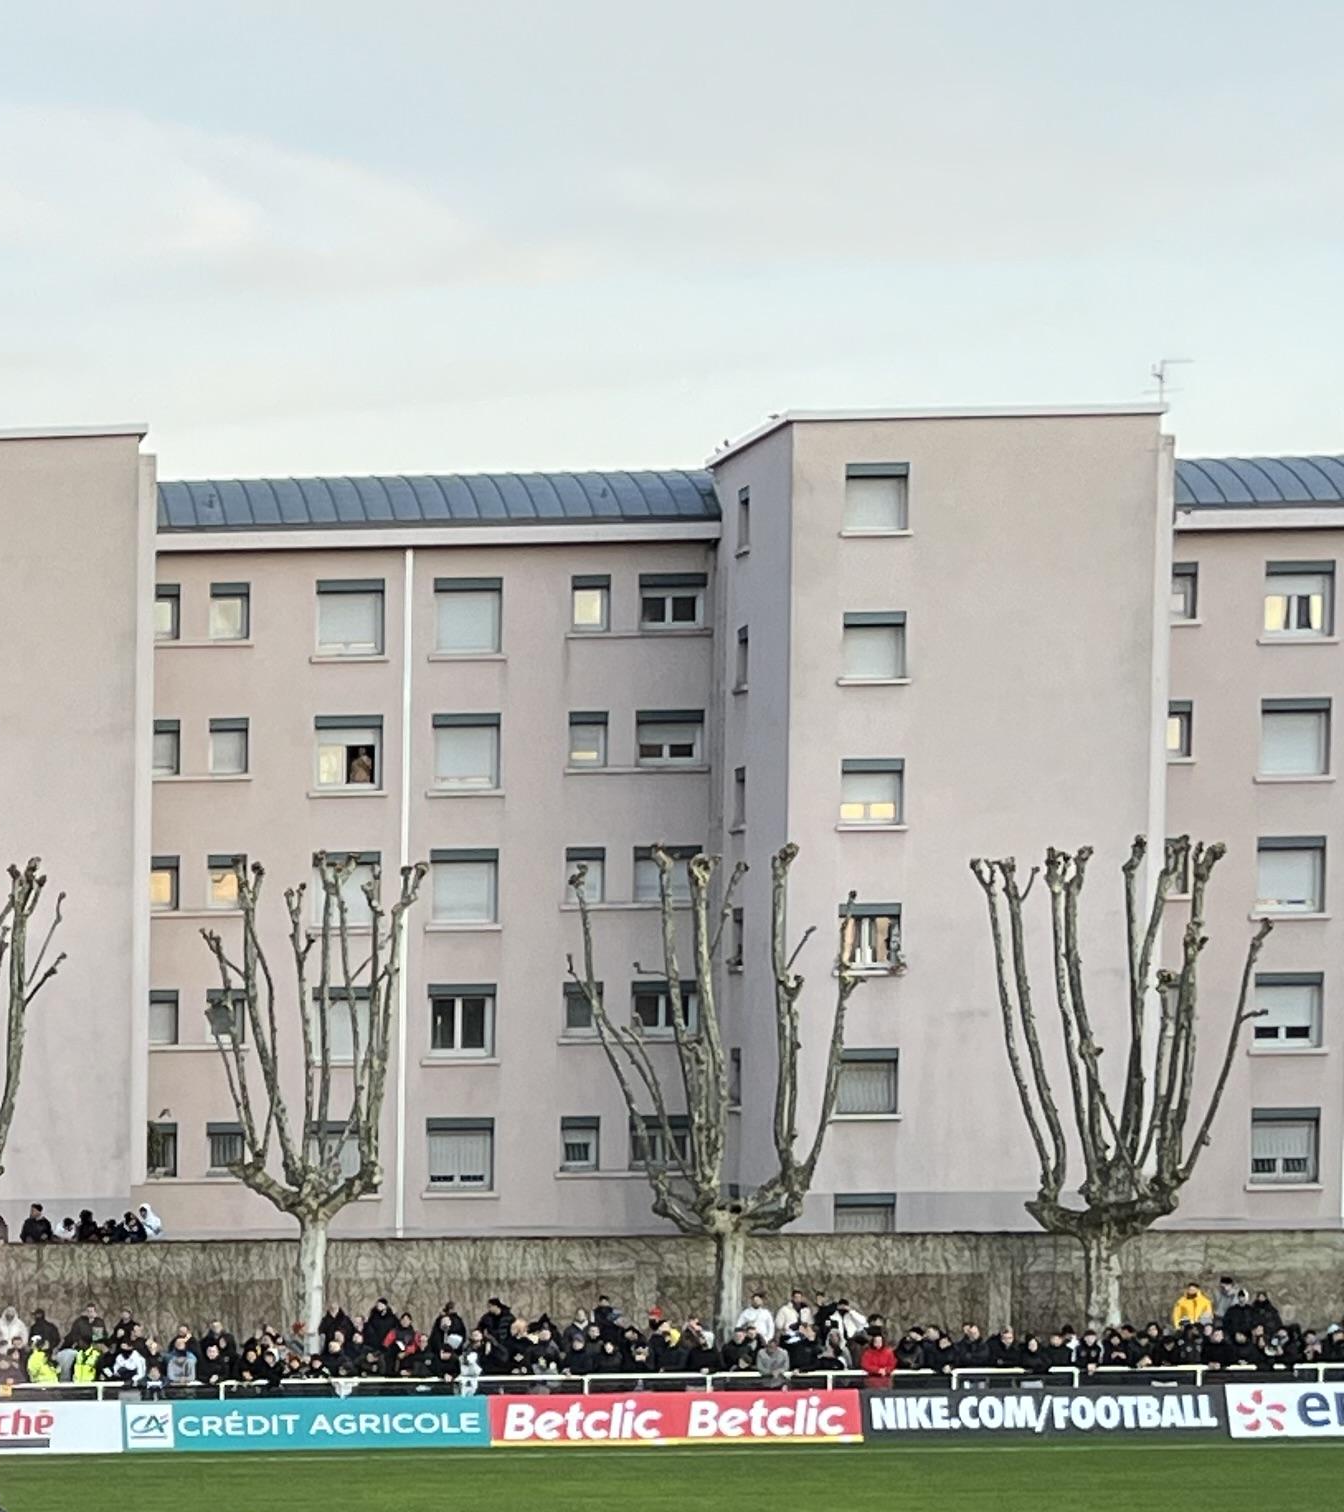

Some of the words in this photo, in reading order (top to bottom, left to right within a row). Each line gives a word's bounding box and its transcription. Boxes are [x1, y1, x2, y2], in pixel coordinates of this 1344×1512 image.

[178, 1410, 300, 1436] CRÉDIT
[309, 1411, 480, 1436] AGRICOLE
[504, 1400, 662, 1440] Betclic
[688, 1397, 846, 1437] Betclic
[870, 1394, 1217, 1432] NIKE.COM/FOOTBALL
